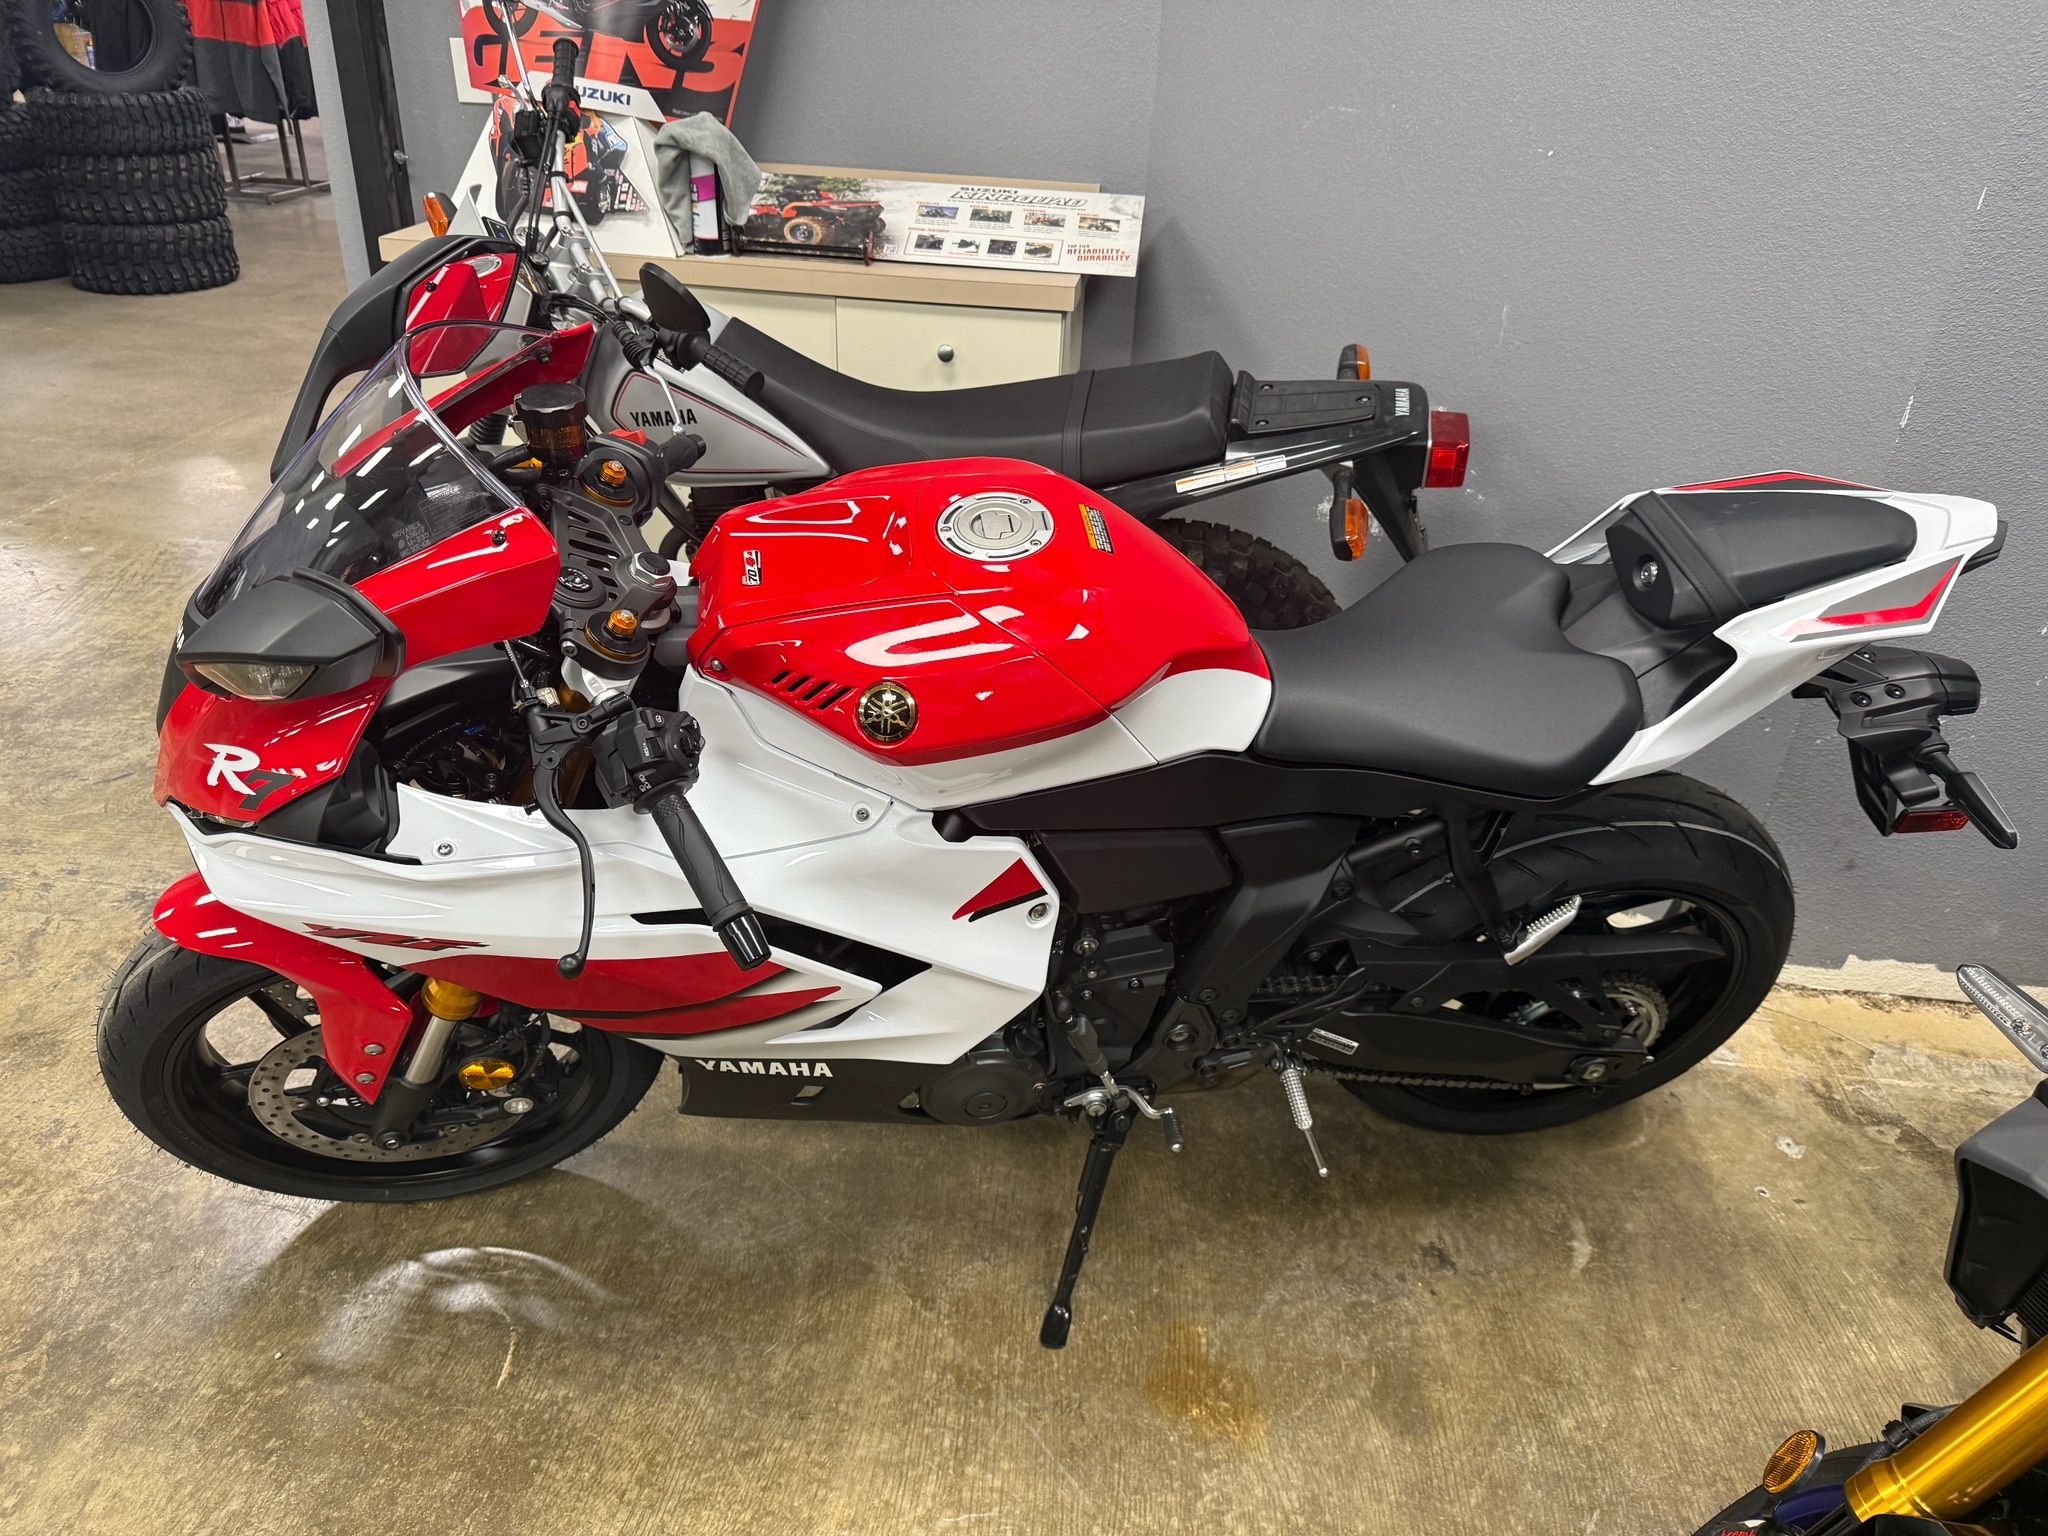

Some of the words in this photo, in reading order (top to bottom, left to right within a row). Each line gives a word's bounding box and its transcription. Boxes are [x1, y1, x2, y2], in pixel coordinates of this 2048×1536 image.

[576, 85, 631, 106] UZUKI
[960, 186, 1018, 195] SUZUKI
[1067, 247, 1121, 255] RELIABILITY
[1394, 388, 1410, 417] YAMAHA
[392, 520, 422, 540] NOVAREX
[203, 743, 301, 810] R7
[695, 1059, 834, 1078] YAMAHA
